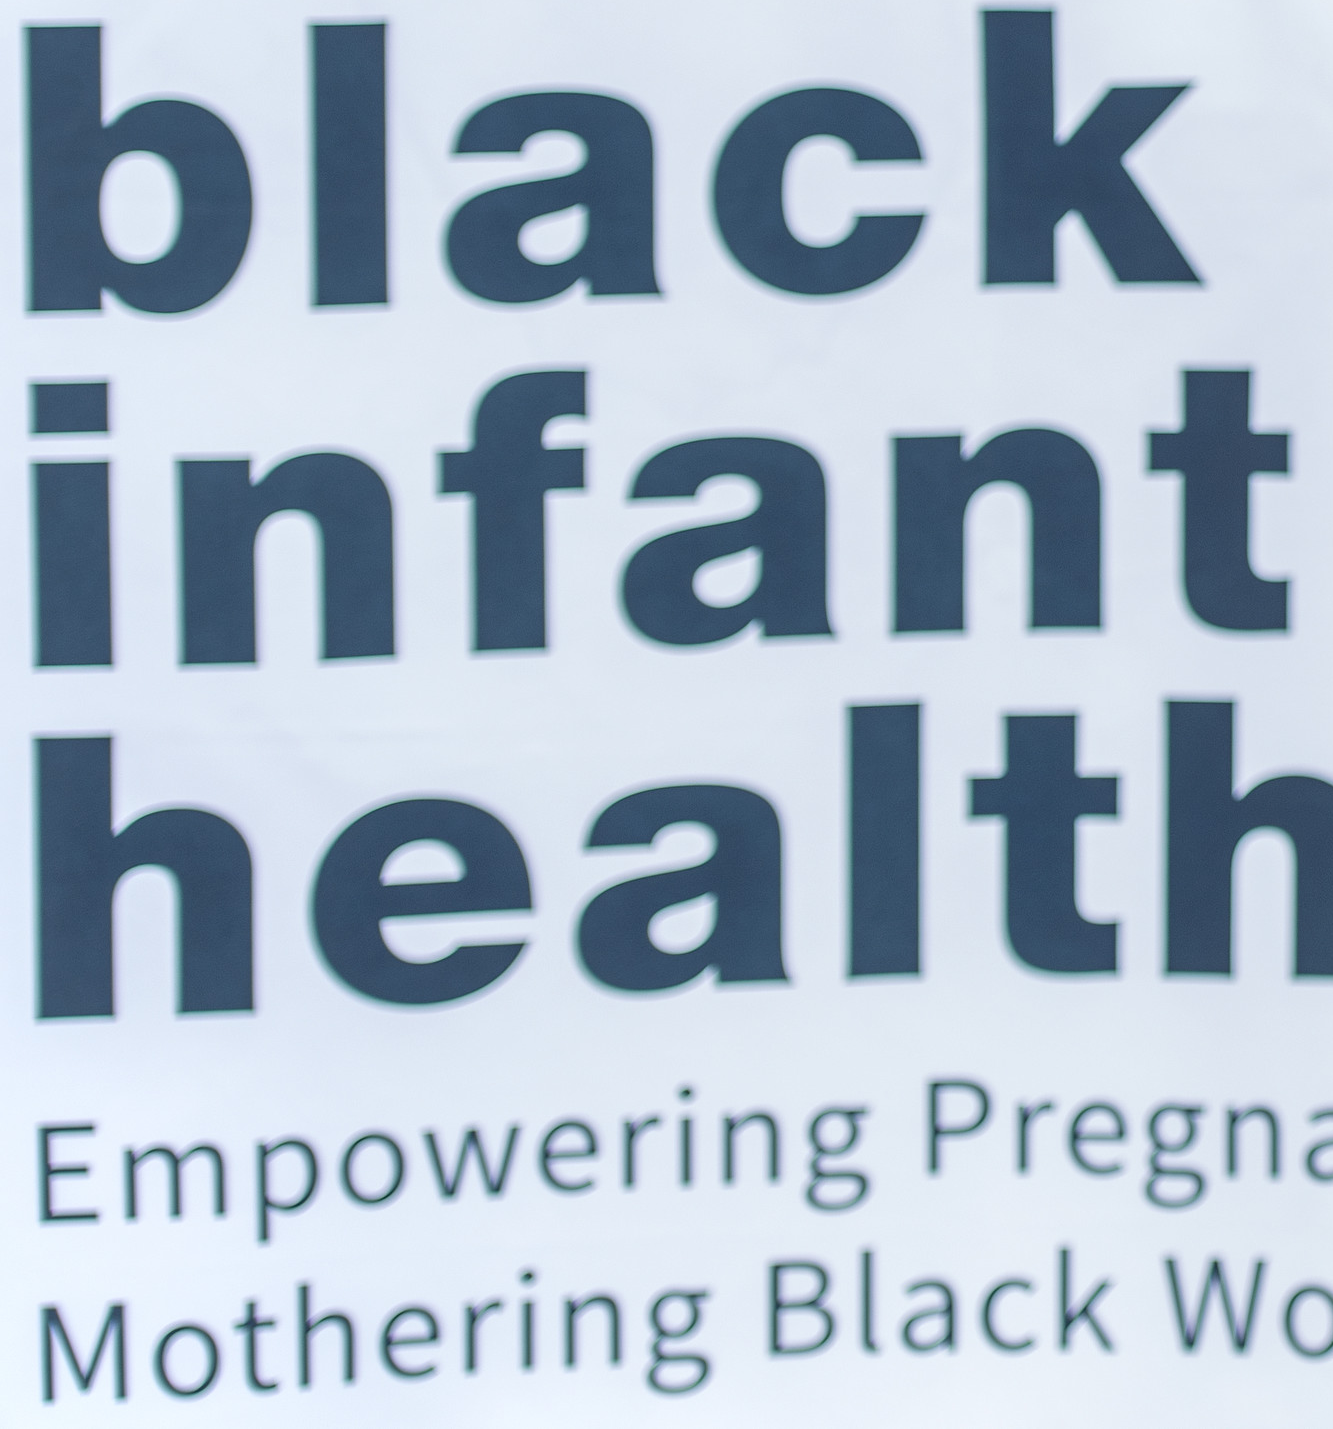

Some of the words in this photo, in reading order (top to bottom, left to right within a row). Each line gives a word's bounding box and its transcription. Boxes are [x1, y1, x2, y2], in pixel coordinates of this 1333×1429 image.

[24, 8, 1204, 316] black
[29, 368, 1291, 669] infant
[37, 1085, 871, 1244] Empowering
[39, 1268, 712, 1404] Mothering
[767, 1245, 1115, 1357] Black
